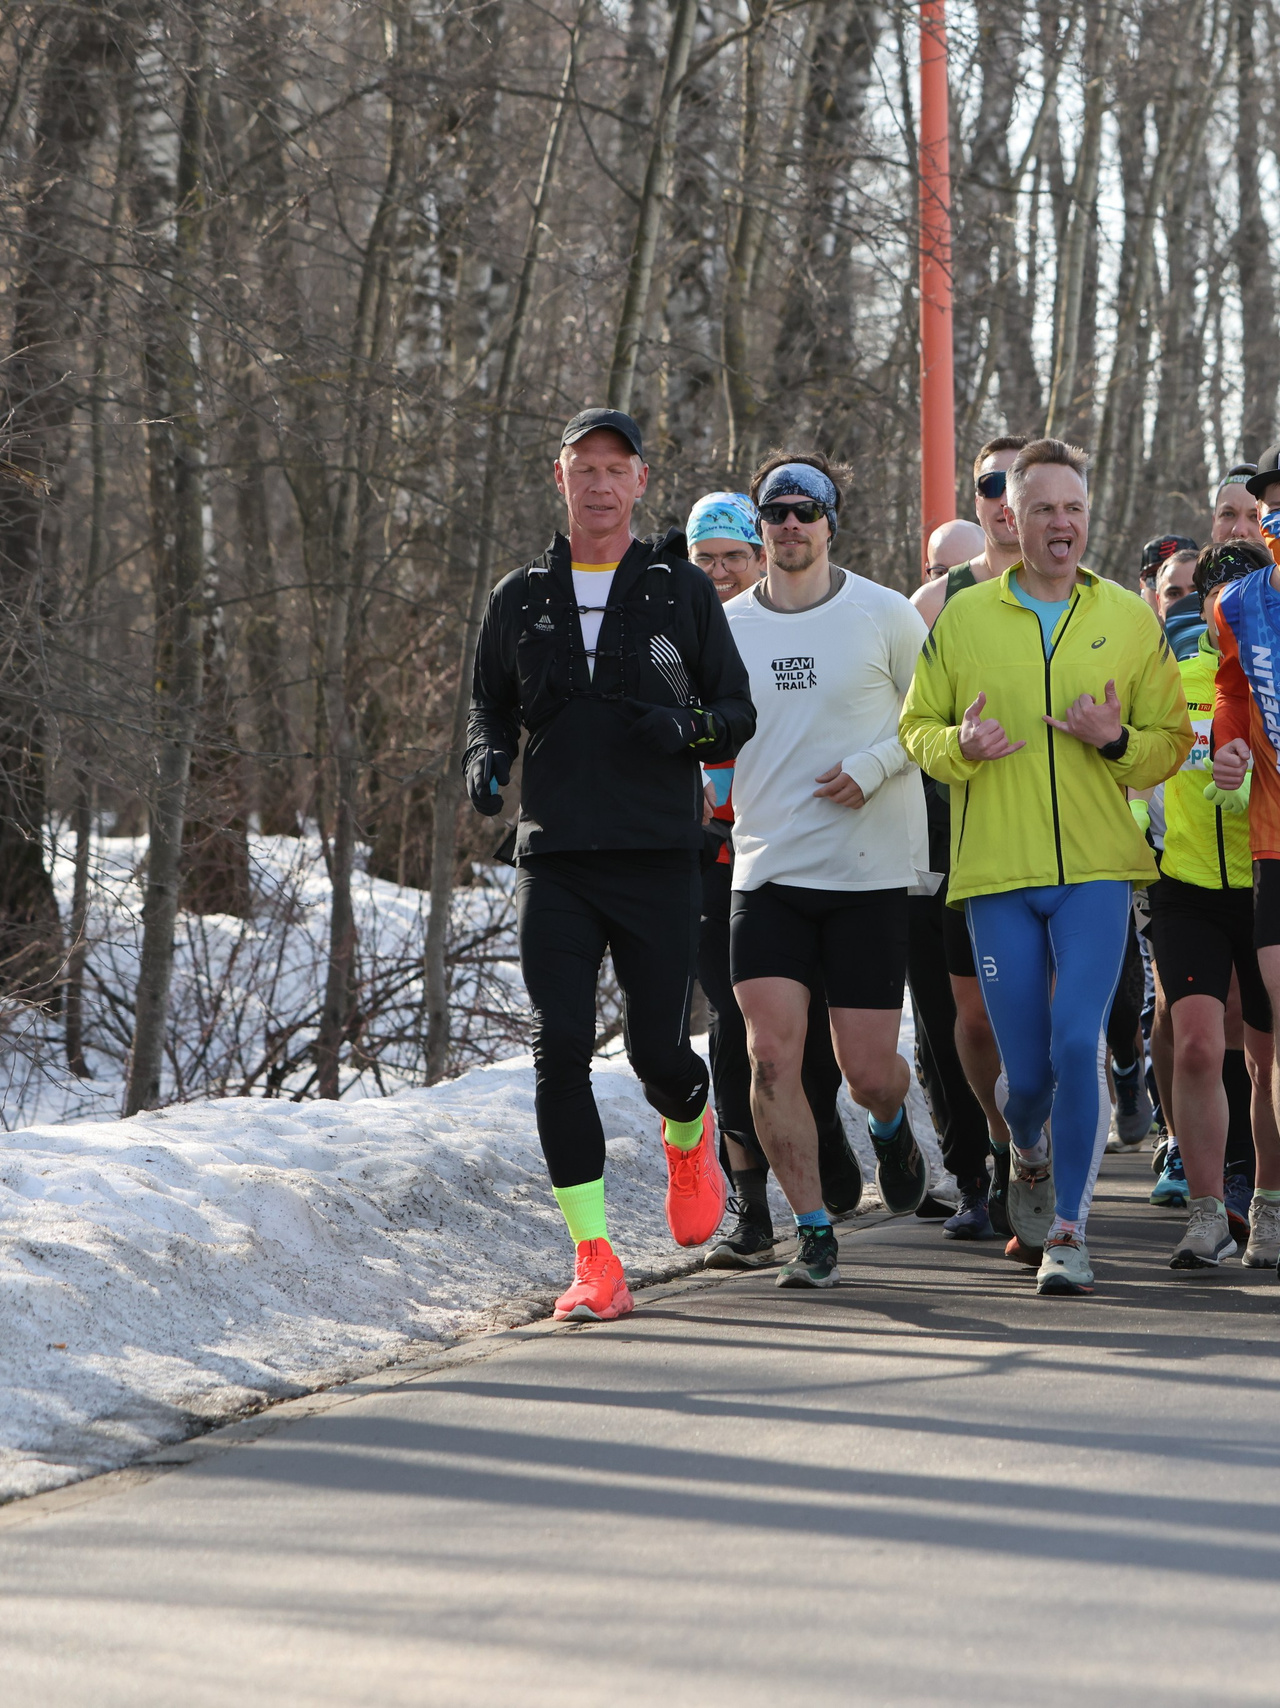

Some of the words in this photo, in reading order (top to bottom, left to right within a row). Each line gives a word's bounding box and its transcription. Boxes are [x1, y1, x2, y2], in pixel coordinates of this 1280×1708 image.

[773, 658, 813, 670] TEAM
[775, 672, 804, 681] WILD
[775, 681, 807, 691] TRAIL
